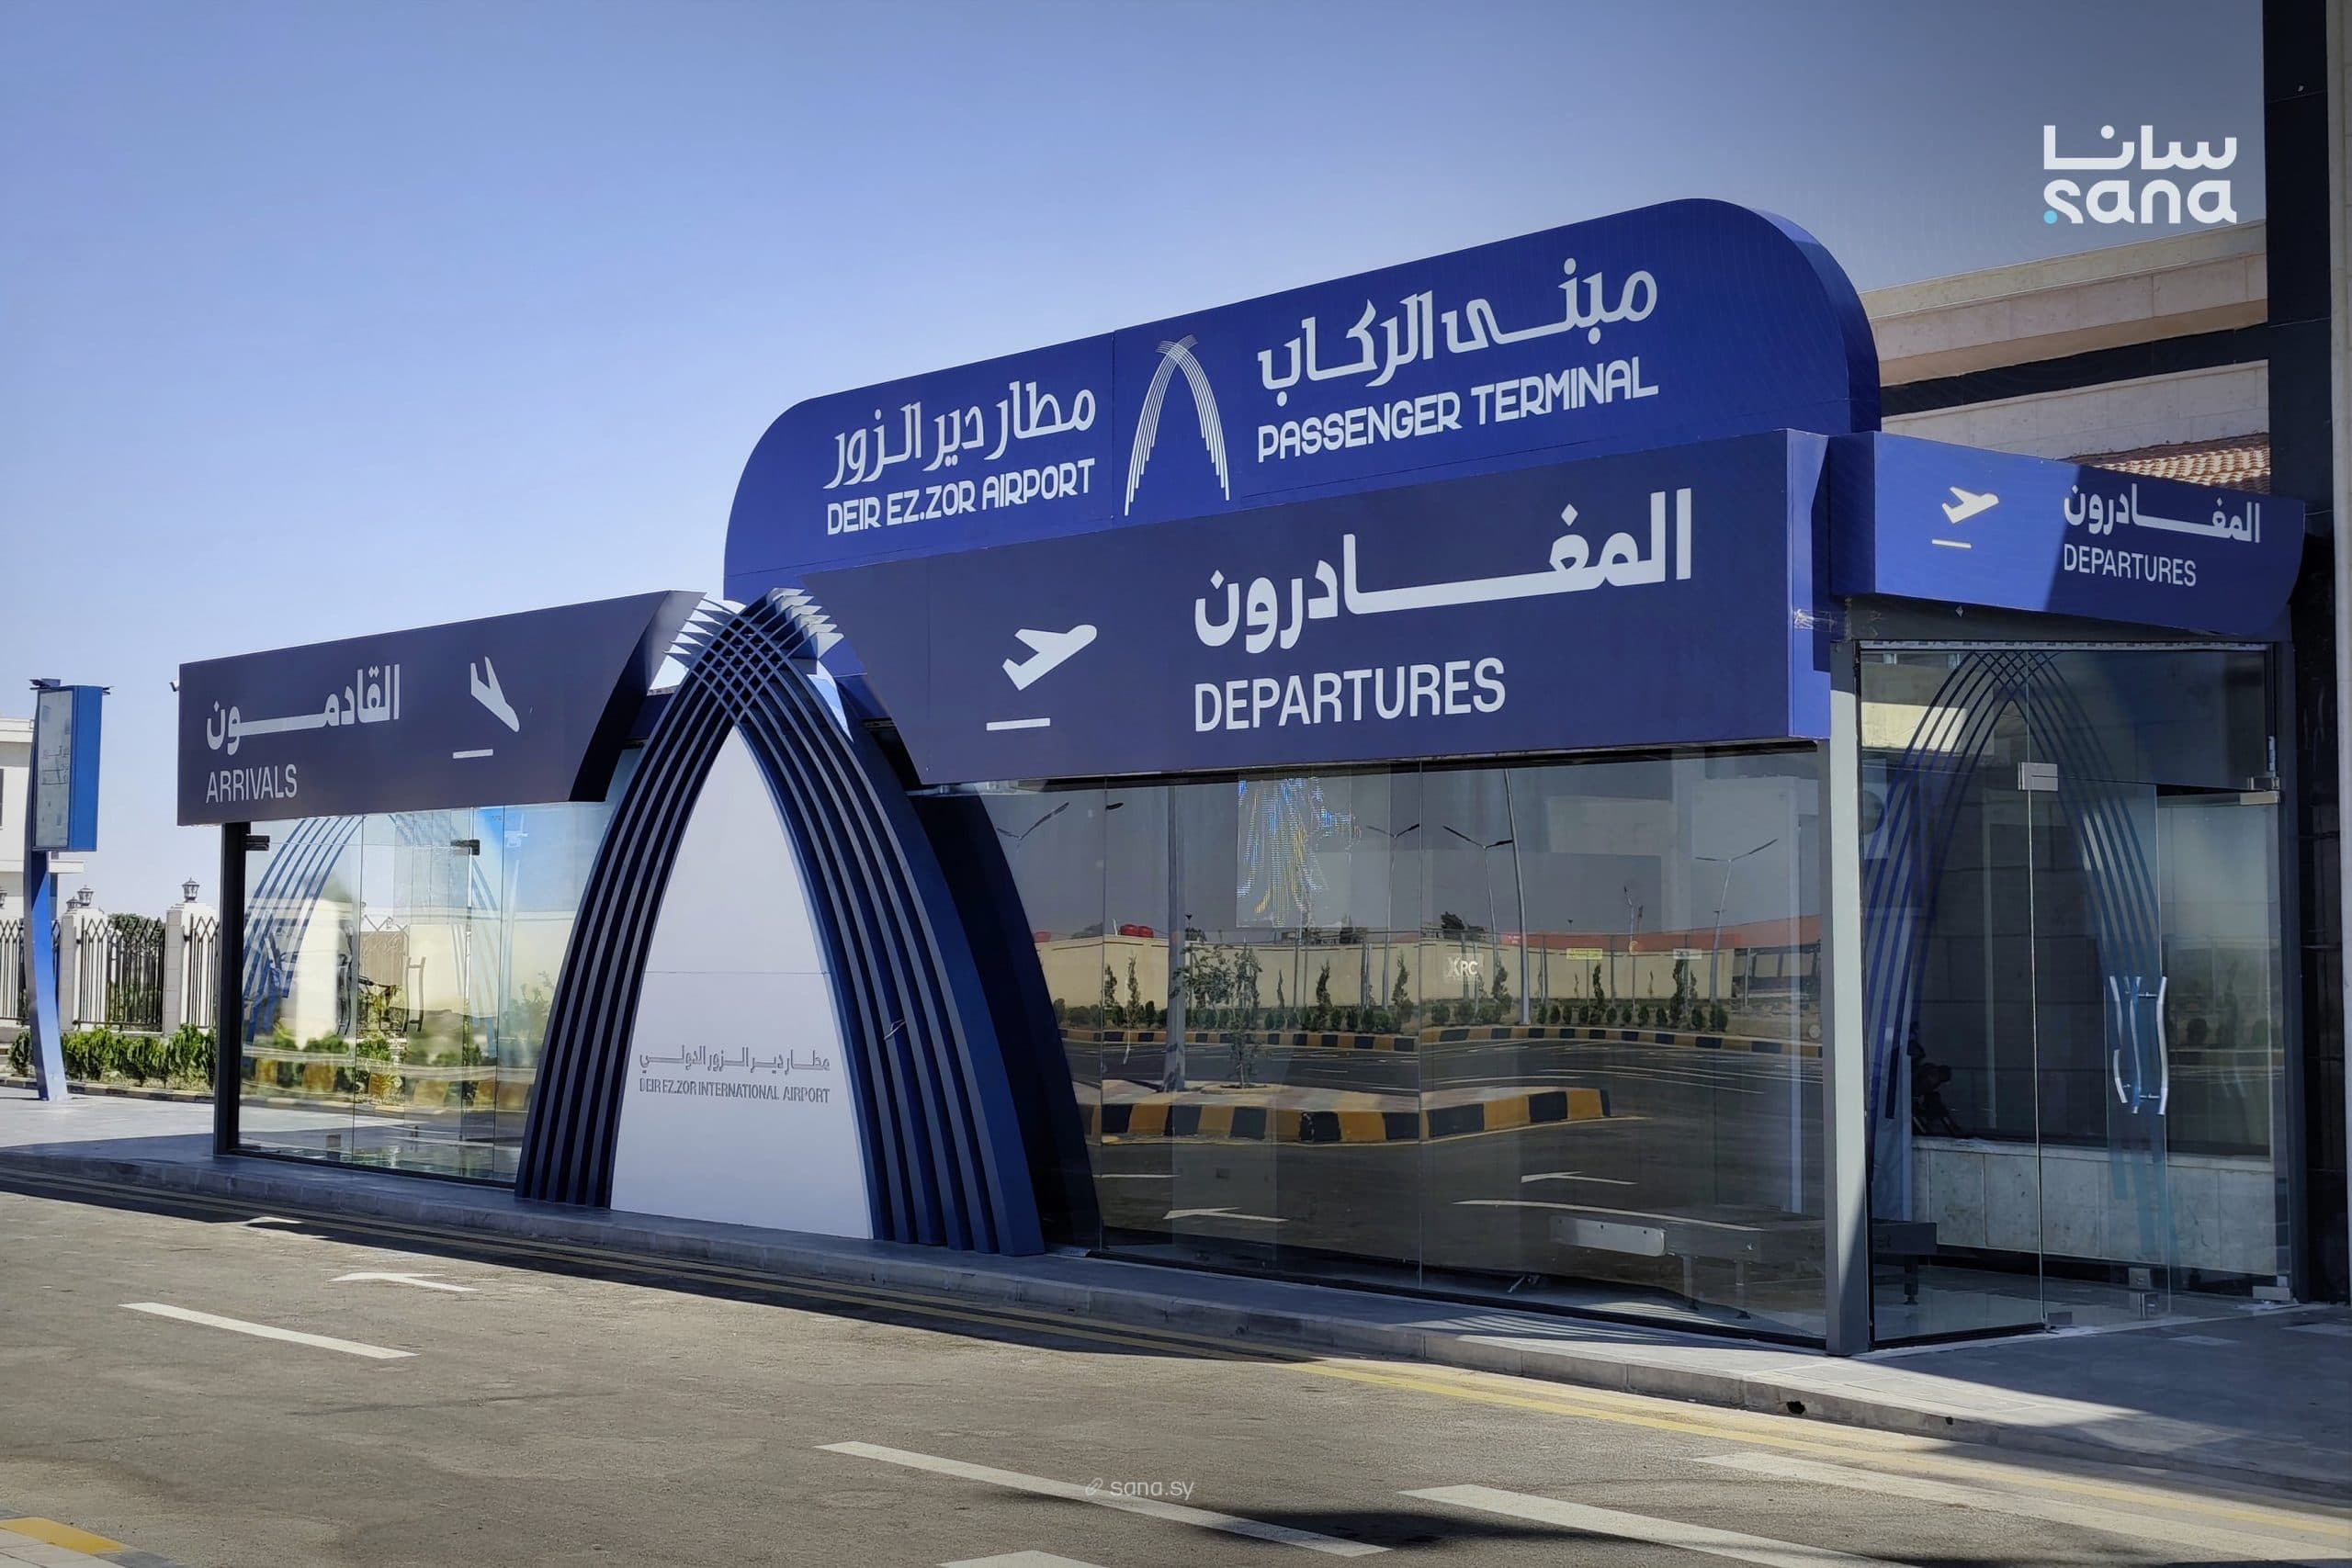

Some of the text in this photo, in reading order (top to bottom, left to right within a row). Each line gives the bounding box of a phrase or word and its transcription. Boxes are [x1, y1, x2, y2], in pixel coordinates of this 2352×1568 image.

[1258, 257, 1657, 407] مبنى الركاب
[823, 380, 1096, 490] مطار دير الزور
[1258, 356, 1658, 463] PASSENGER TERMINAL
[827, 496, 881, 536] DEIR
[982, 457, 1095, 511] AIRPORT
[2064, 483, 2260, 543] المغادرون
[1194, 488, 1691, 654] المغادرون
[2064, 544, 2197, 587] DEPARTURES
[207, 664, 400, 755] القادمون
[1194, 657, 1506, 732] DEPARTURES
[206, 763, 298, 804] ARRIVALS
[639, 1044, 831, 1076] مطار دير الزور الدولي
[698, 1081, 779, 1100] INTERNATIONAL
[783, 1086, 831, 1103] AIRPORT
